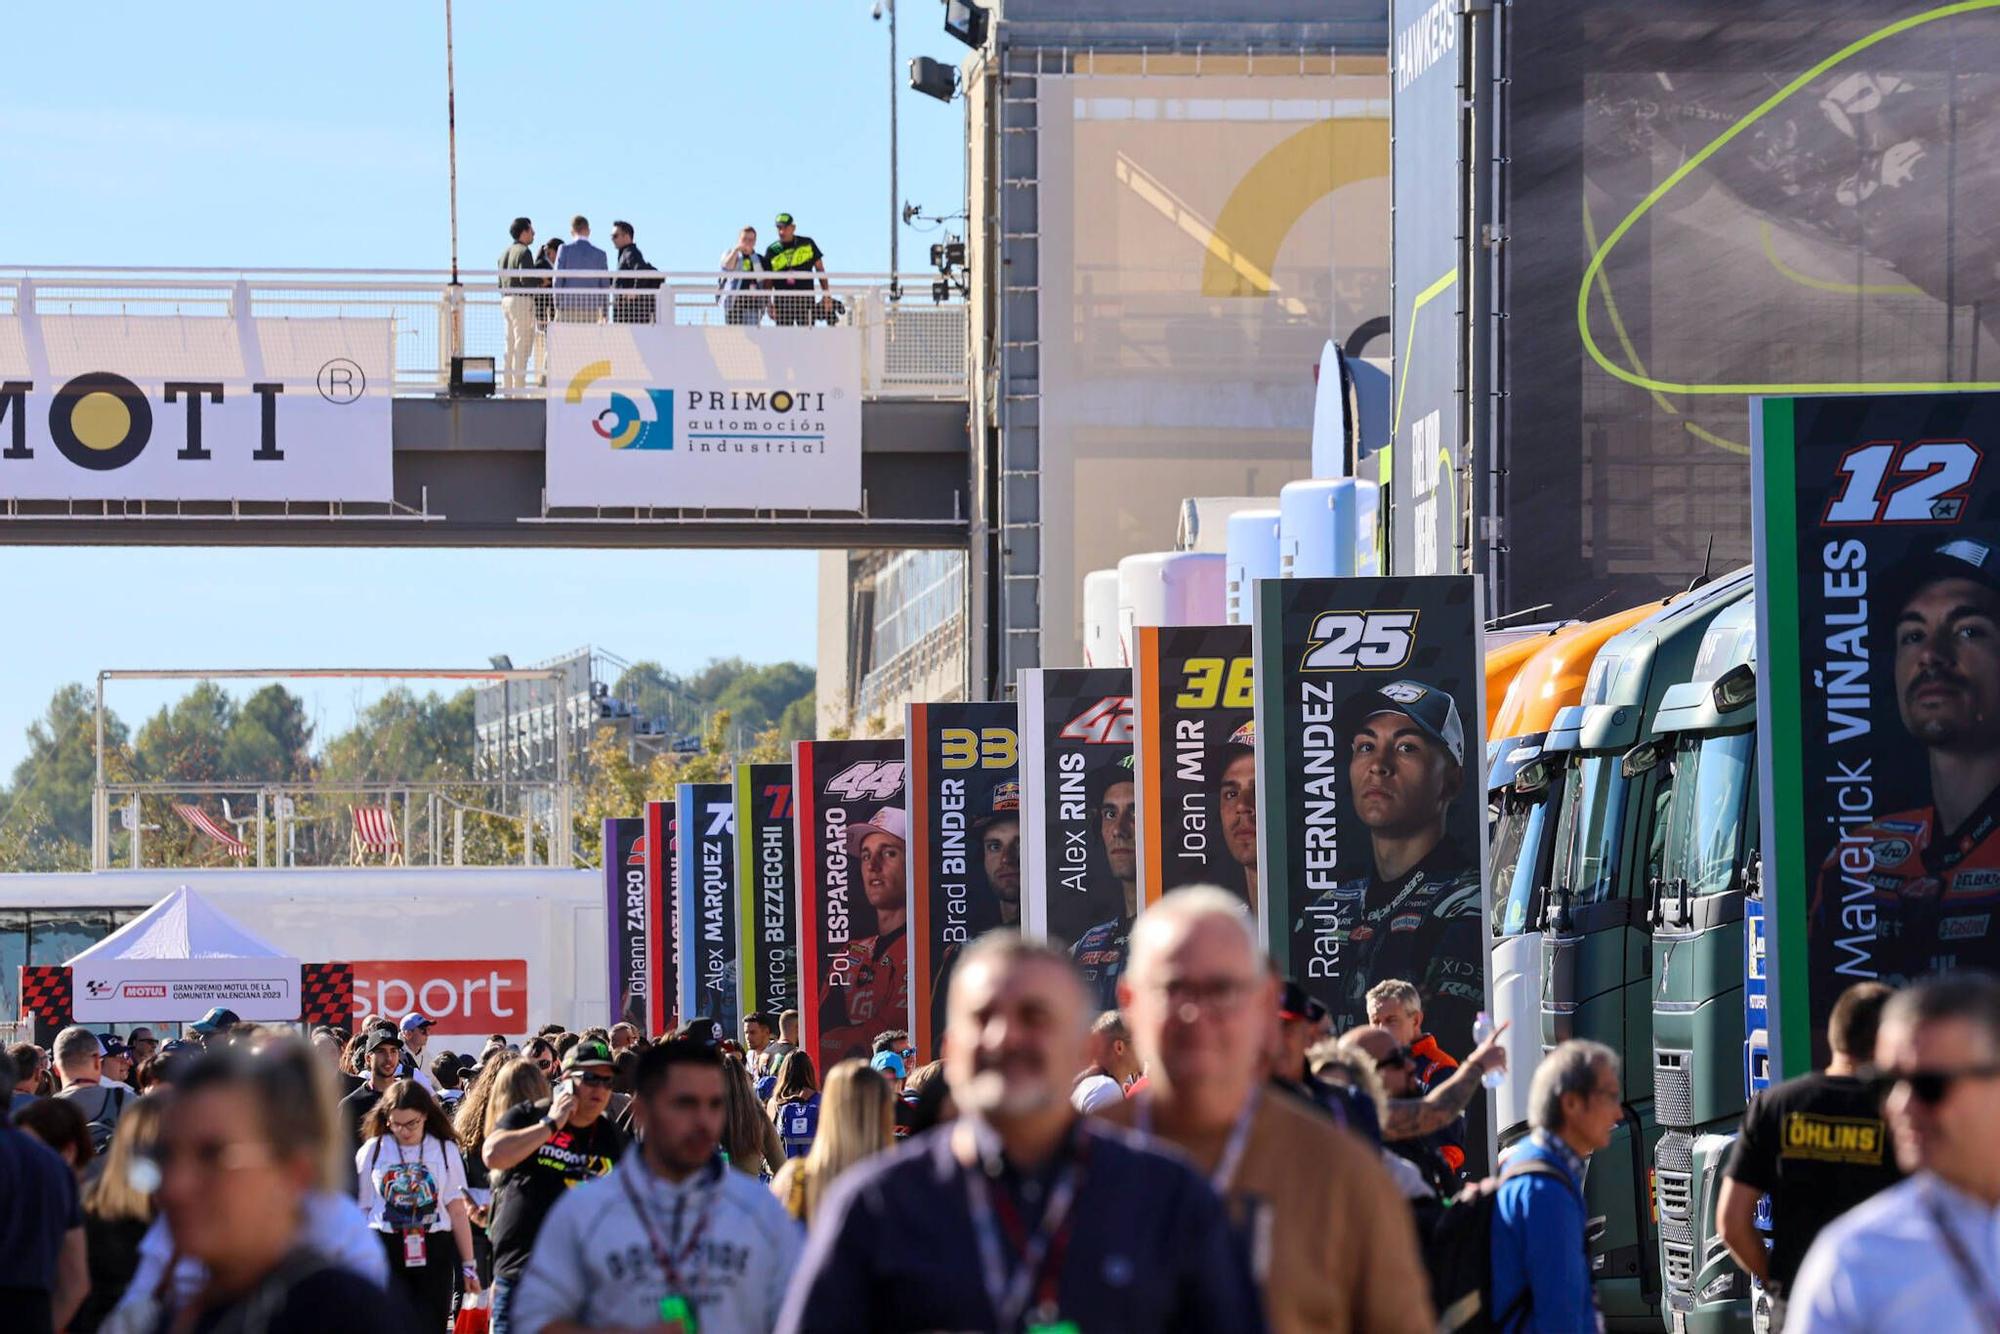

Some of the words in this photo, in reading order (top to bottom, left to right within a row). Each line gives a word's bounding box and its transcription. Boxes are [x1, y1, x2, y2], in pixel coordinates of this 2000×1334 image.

[688, 390, 824, 414] PRIMOTI
[688, 419, 825, 432] automoción
[688, 440, 825, 454] industrial
[1820, 438, 1984, 526] 12
[1300, 609, 1420, 671] 25
[1813, 538, 1871, 744] VIÑALES
[941, 728, 1018, 770] 33
[1176, 719, 1205, 782] MIR
[824, 760, 906, 802] 44
[1059, 752, 1086, 820] RINS
[1302, 681, 1338, 892] FERNANDEZ
[941, 778, 966, 875] BINDER
[1178, 792, 1207, 865] Joan
[703, 841, 727, 942] MARQUEZ
[762, 826, 785, 942] BEZZECCHI
[825, 806, 850, 943] ESPARGARO
[1059, 830, 1087, 892] Alex
[1826, 758, 1878, 979] Maverick
[627, 870, 644, 932] ZARCO
[941, 883, 967, 943] Brad
[628, 935, 646, 1000] Johann
[706, 948, 724, 992] Alex
[827, 949, 851, 987] Pol
[1305, 900, 1340, 979] Raul
[126, 987, 165, 998] MOTUL
[173, 983, 193, 991] GRAN
[194, 983, 222, 991] PREMIO
[223, 983, 249, 991] MOTUL
[250, 983, 262, 991] DE
[263, 983, 271, 991] LA
[173, 991, 215, 1000] COMUNITAT
[216, 991, 261, 999] VALENCIANA
[262, 991, 281, 999] 2023
[353, 971, 514, 1020] sport
[767, 948, 786, 1016] Marco
[1790, 1111, 1874, 1151] ÖHLINS
